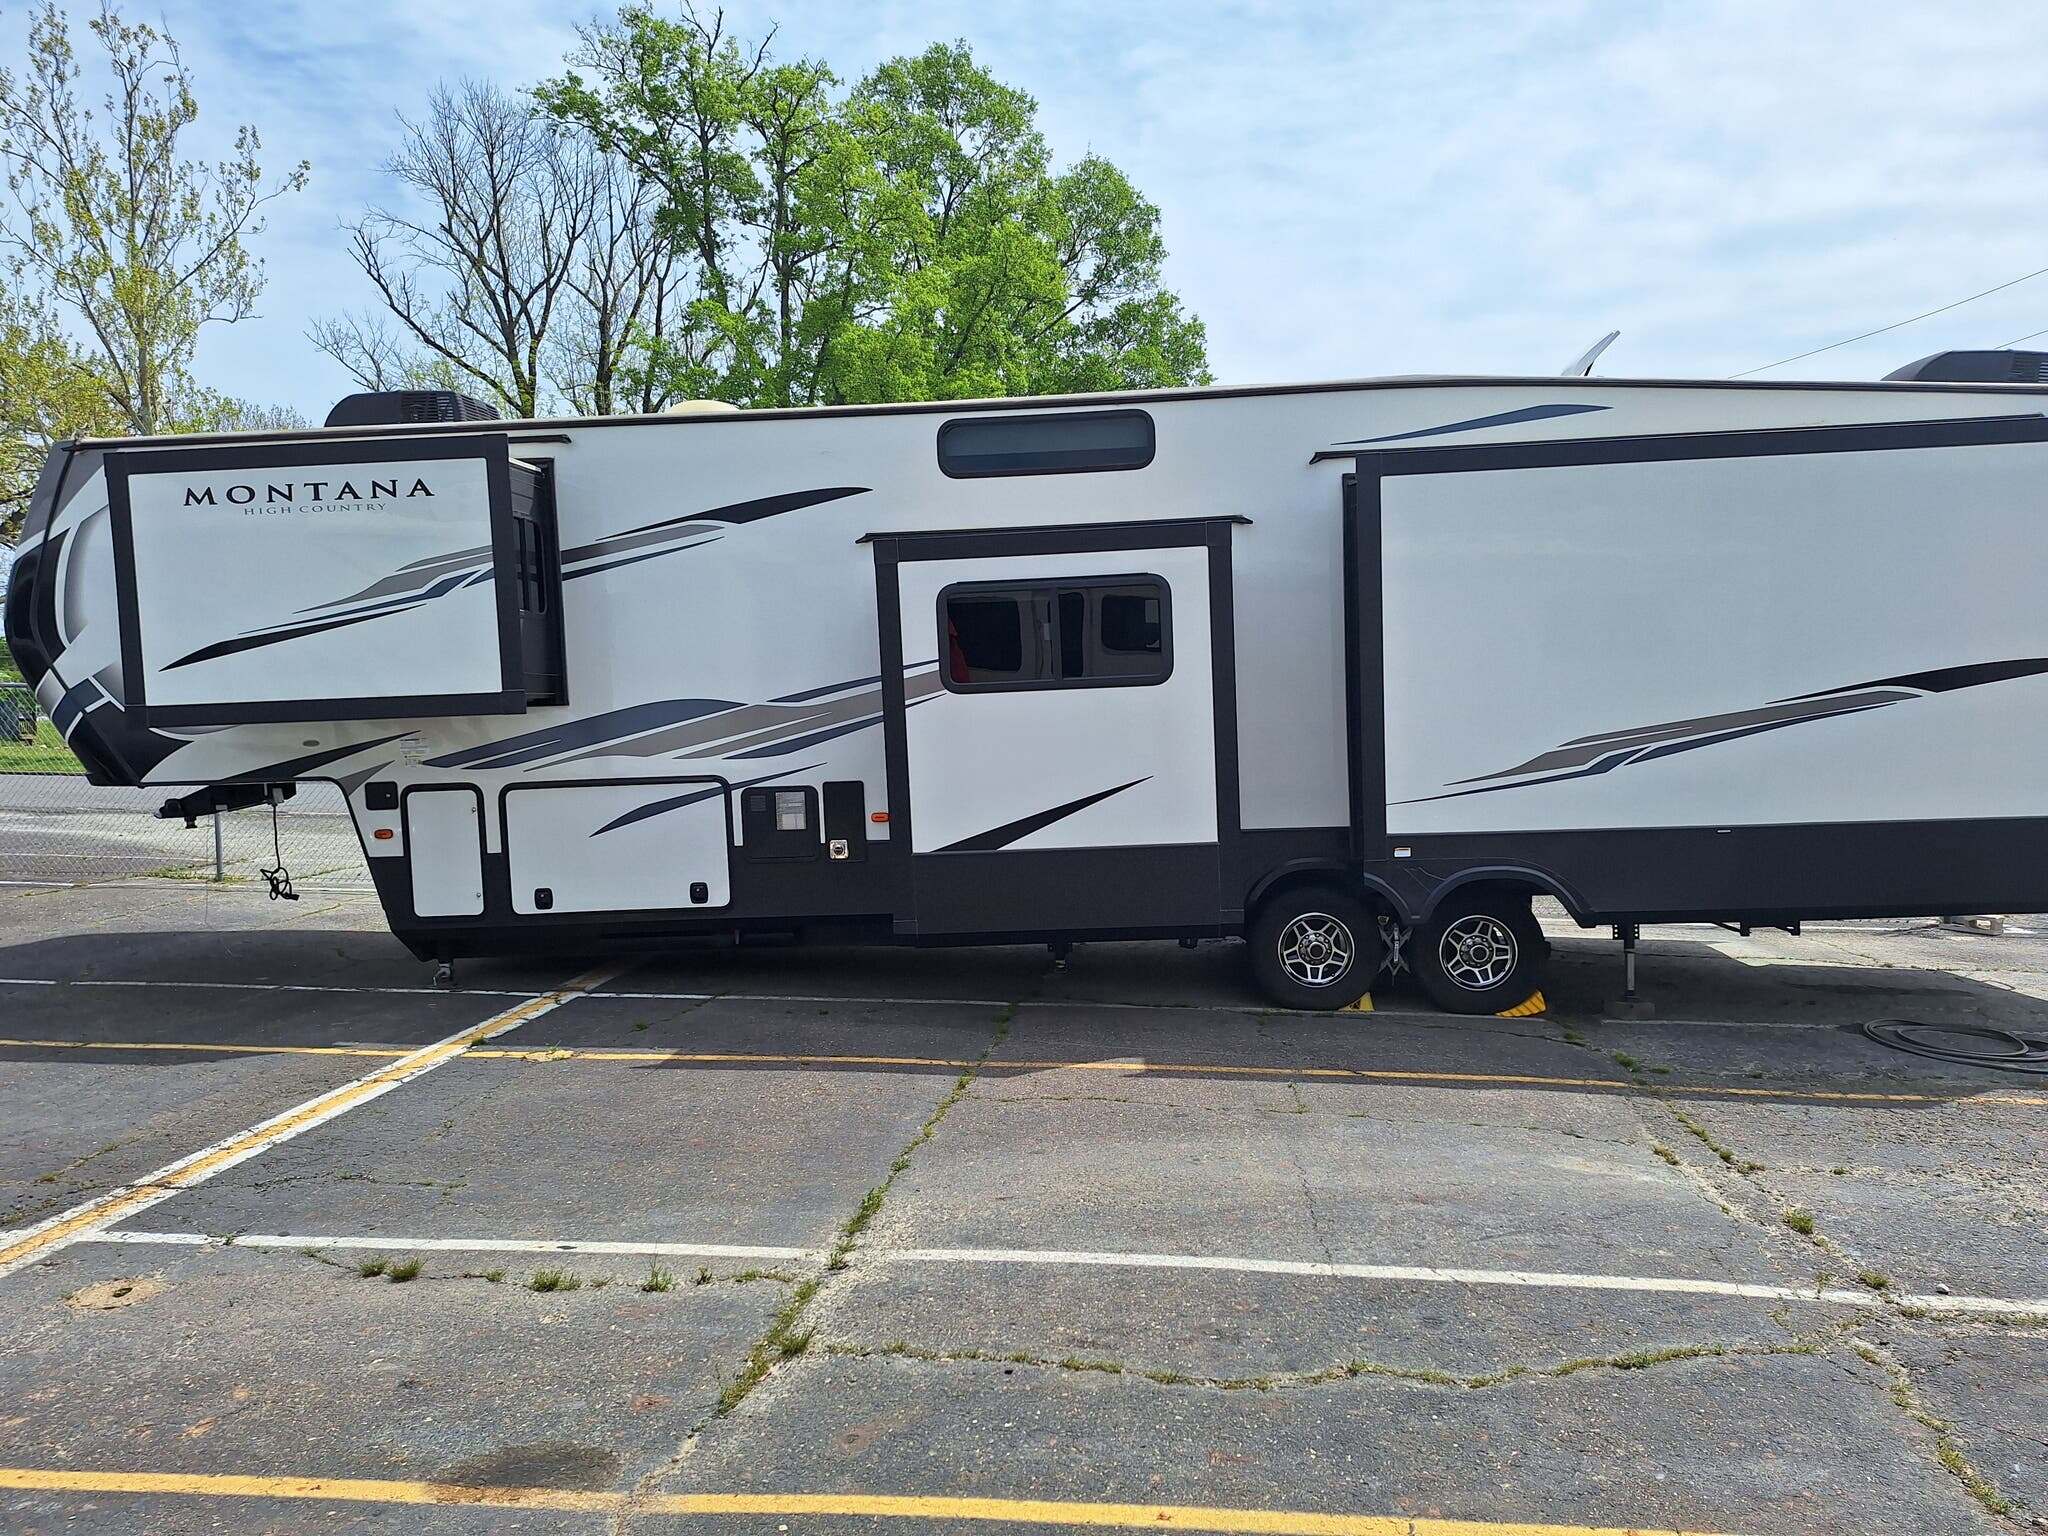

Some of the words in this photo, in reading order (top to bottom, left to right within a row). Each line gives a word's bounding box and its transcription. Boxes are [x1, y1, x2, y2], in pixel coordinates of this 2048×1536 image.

[183, 478, 435, 506] MONTANA
[244, 506, 291, 516] HIGH
[299, 502, 387, 514] COUNTRY
